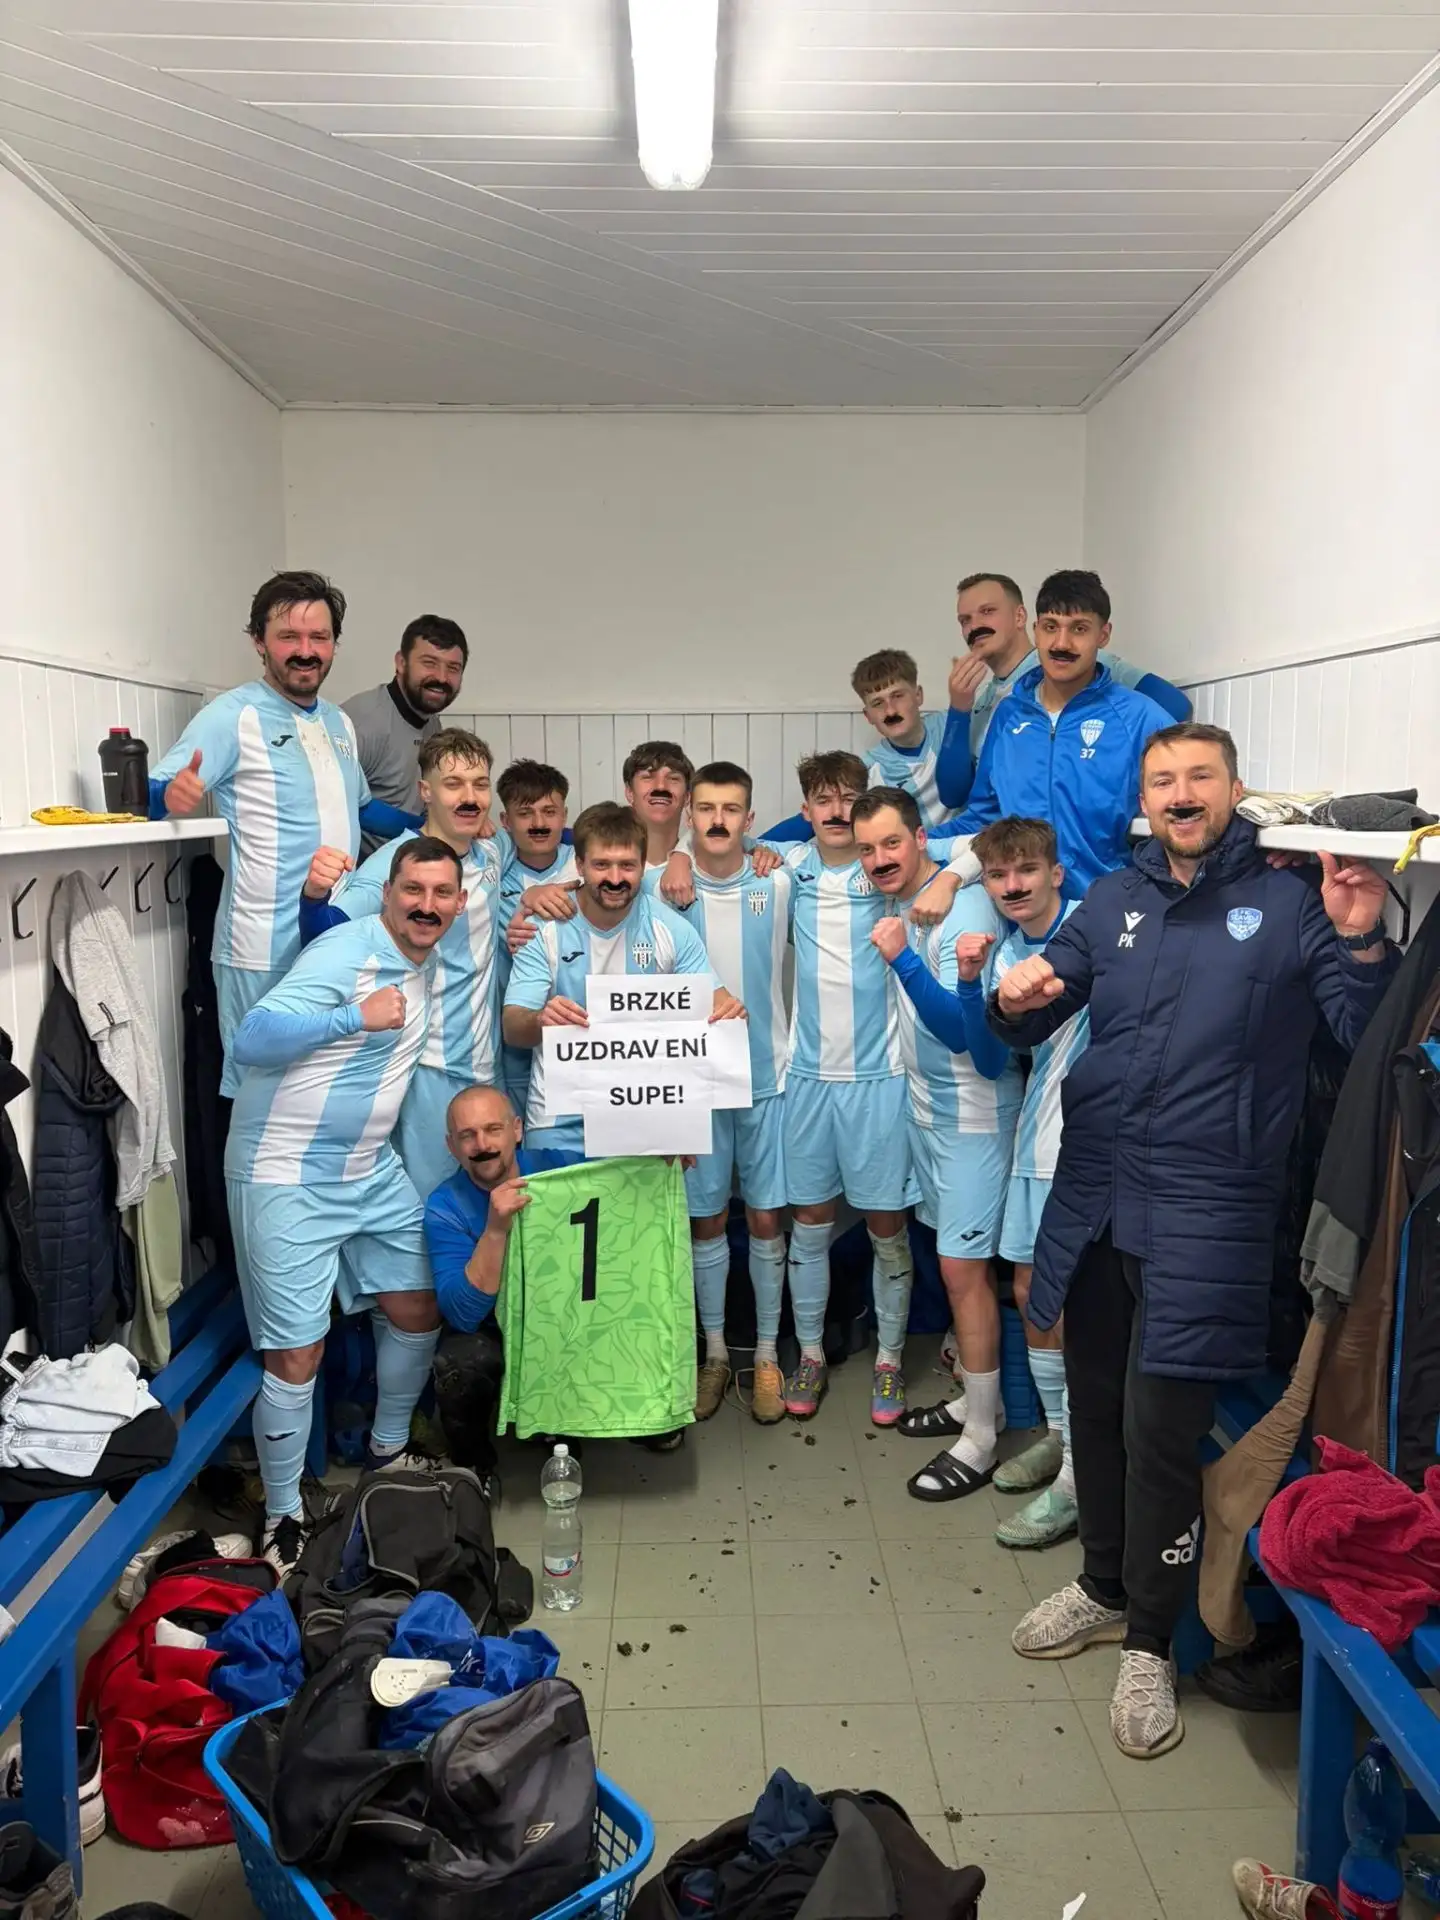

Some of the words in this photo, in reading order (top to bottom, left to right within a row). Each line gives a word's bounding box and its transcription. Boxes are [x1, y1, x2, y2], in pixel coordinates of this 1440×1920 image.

[1080, 747, 1096, 759] 37
[1118, 932, 1137, 948] PK
[610, 986, 691, 1011] BRZKÉ
[610, 1085, 684, 1106] SUPE!
[569, 1197, 601, 1302] 1
